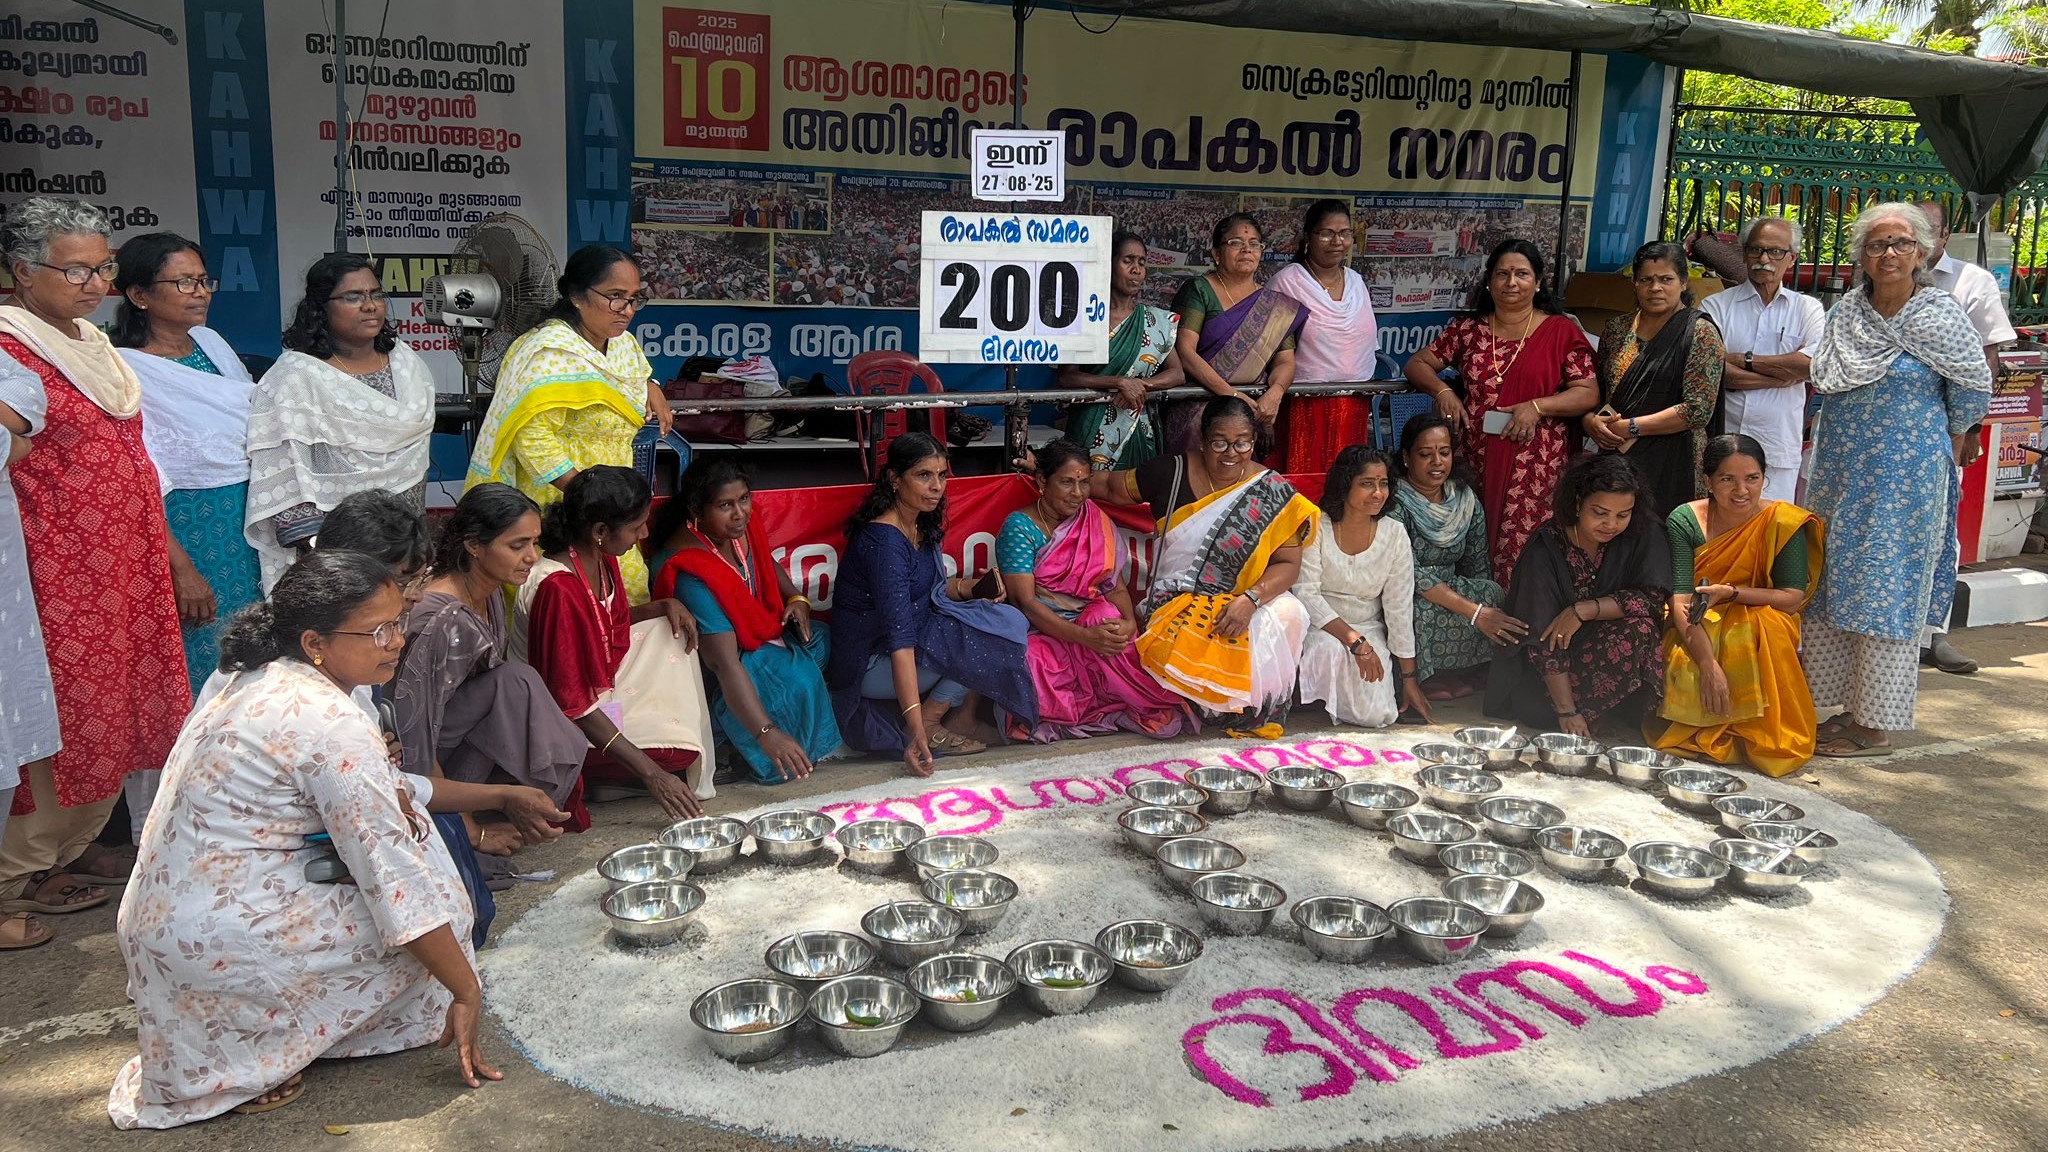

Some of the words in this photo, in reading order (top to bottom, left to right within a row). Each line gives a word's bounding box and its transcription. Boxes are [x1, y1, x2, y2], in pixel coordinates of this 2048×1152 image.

[698, 16, 737, 29] 2025
[668, 30, 764, 56] ഫെബ്രുവരി
[671, 56, 756, 122] 10
[783, 54, 1029, 114] ആശമാരുടെ
[1242, 63, 1471, 110] സെക്രട്ടേറിയറ്റിനു
[1480, 76, 1572, 112] മുന്നിൽ
[86, 94, 149, 122] രൂപ
[366, 93, 477, 122] മുഴുവൻ
[575, 38, 628, 242] KAHW
[685, 124, 748, 139] മുതൽ
[1047, 108, 1361, 179] രാപകൽ
[1388, 125, 1569, 184] സമരം
[987, 140, 1052, 168] ഇന്ന്
[660, 166, 680, 175] 2025
[368, 191, 433, 207] മാസവും
[439, 193, 521, 208] മുടങ്ങാതെ
[1600, 112, 1639, 264] KAHW
[940, 215, 1022, 243] രാപകൽ
[1026, 217, 1090, 243] സമരം
[939, 261, 1080, 332] 200
[636, 322, 772, 360] കേരള
[790, 324, 903, 365] ആശ
[981, 334, 1060, 362] ദിവസം
[1182, 950, 1709, 1107] ദിവസം
